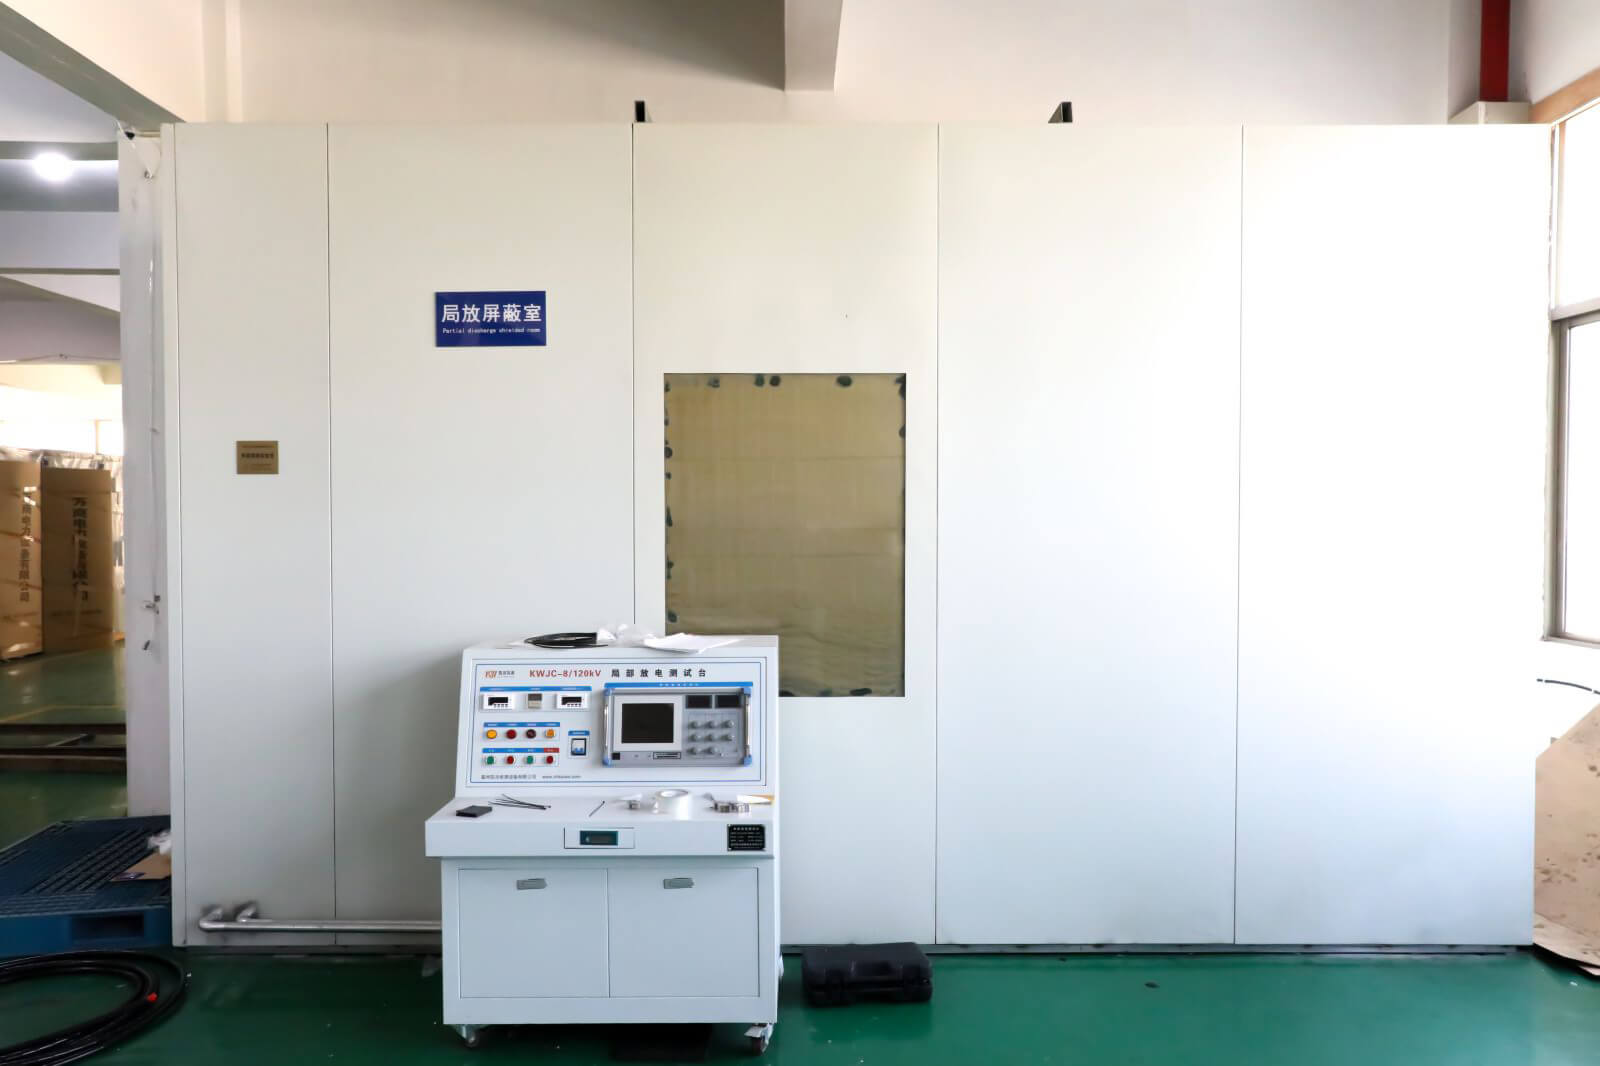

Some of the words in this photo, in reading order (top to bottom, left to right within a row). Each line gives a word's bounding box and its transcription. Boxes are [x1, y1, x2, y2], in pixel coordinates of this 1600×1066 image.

[441, 303, 542, 323] 局放屏蔽室
[529, 669, 602, 678] KWJC-8/120kV
[611, 668, 707, 678] 局部放电测试台
